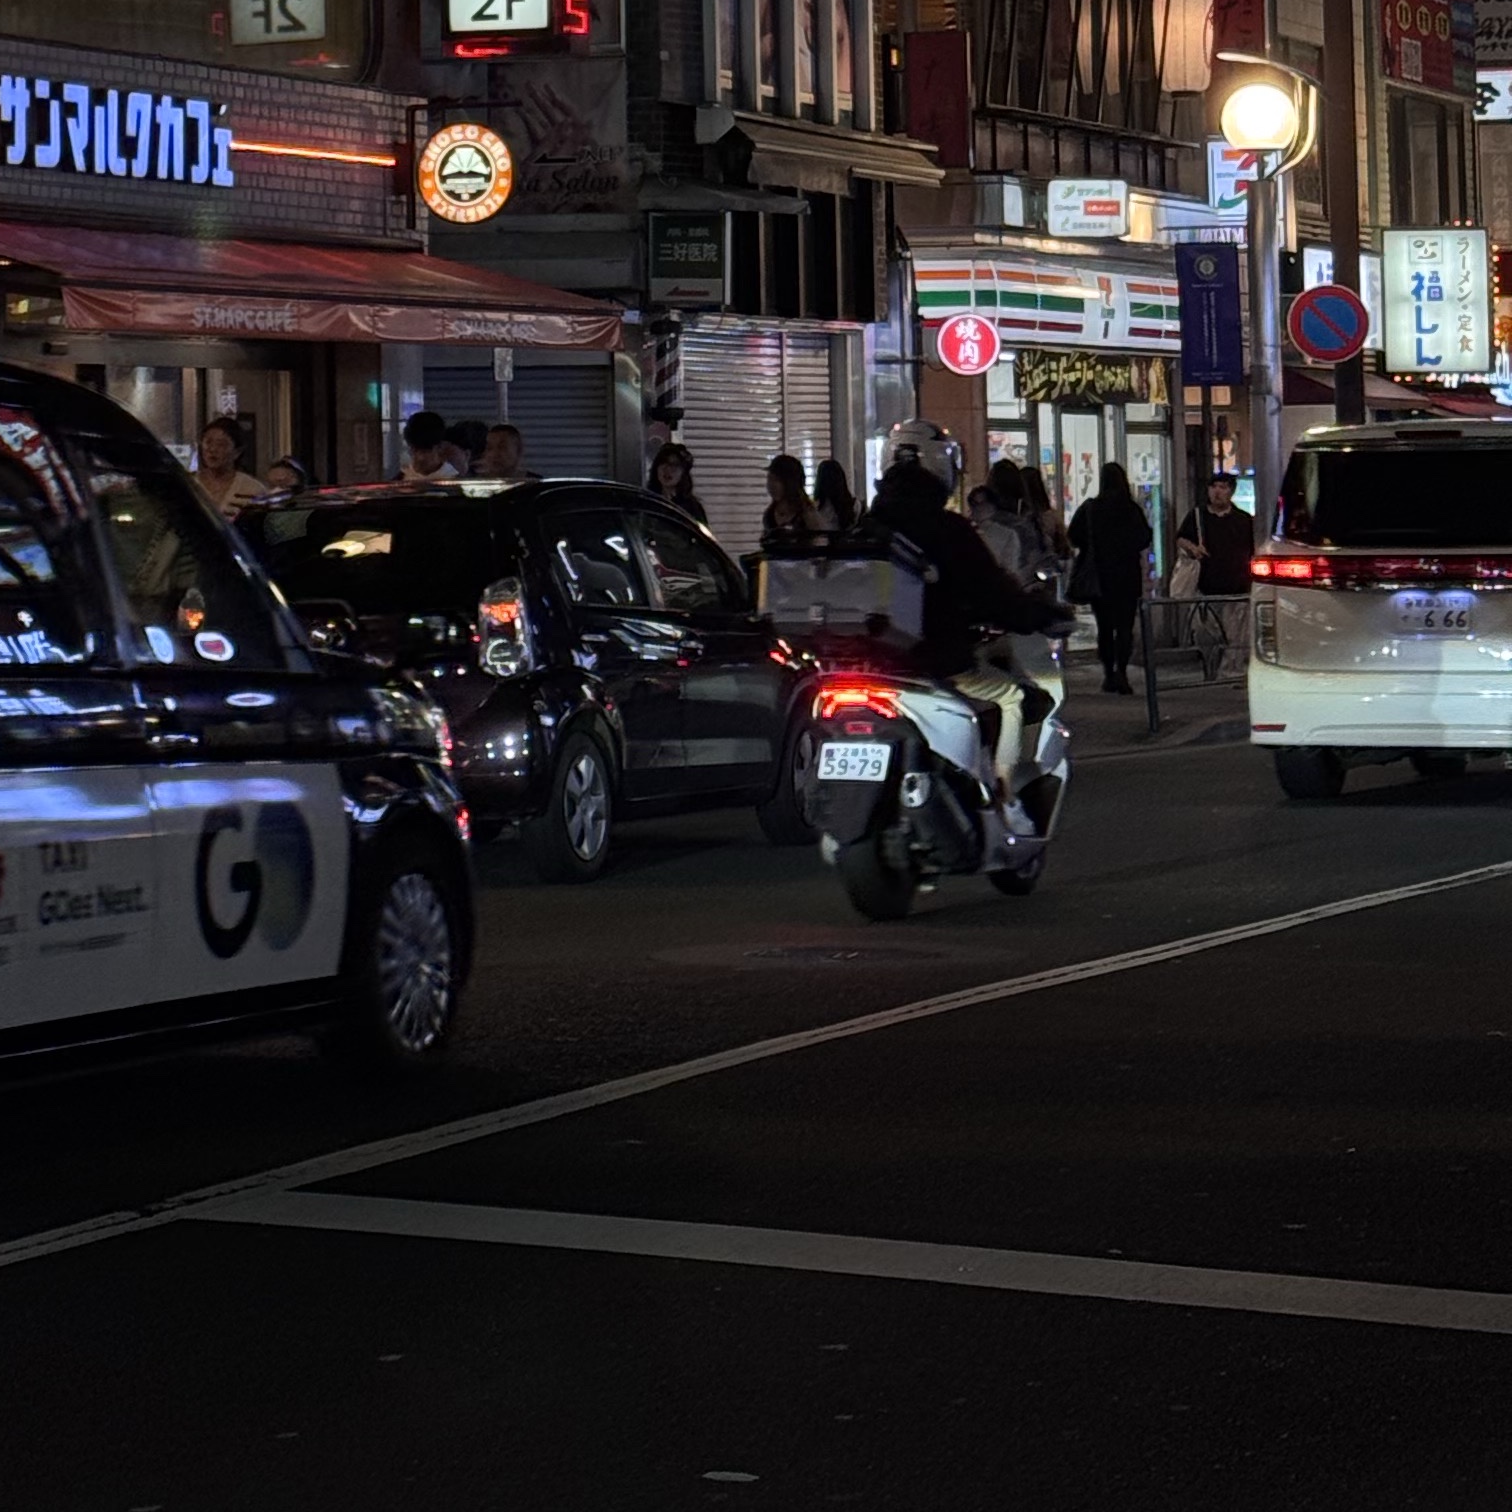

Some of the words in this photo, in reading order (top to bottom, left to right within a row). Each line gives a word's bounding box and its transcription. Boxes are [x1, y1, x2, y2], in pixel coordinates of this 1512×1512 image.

[1410, 270, 1445, 367] 福しん
[1456, 236, 1474, 354] ラーメン・定食
[954, 318, 983, 366] 焼肉
[823, 759, 883, 777] 59-79
